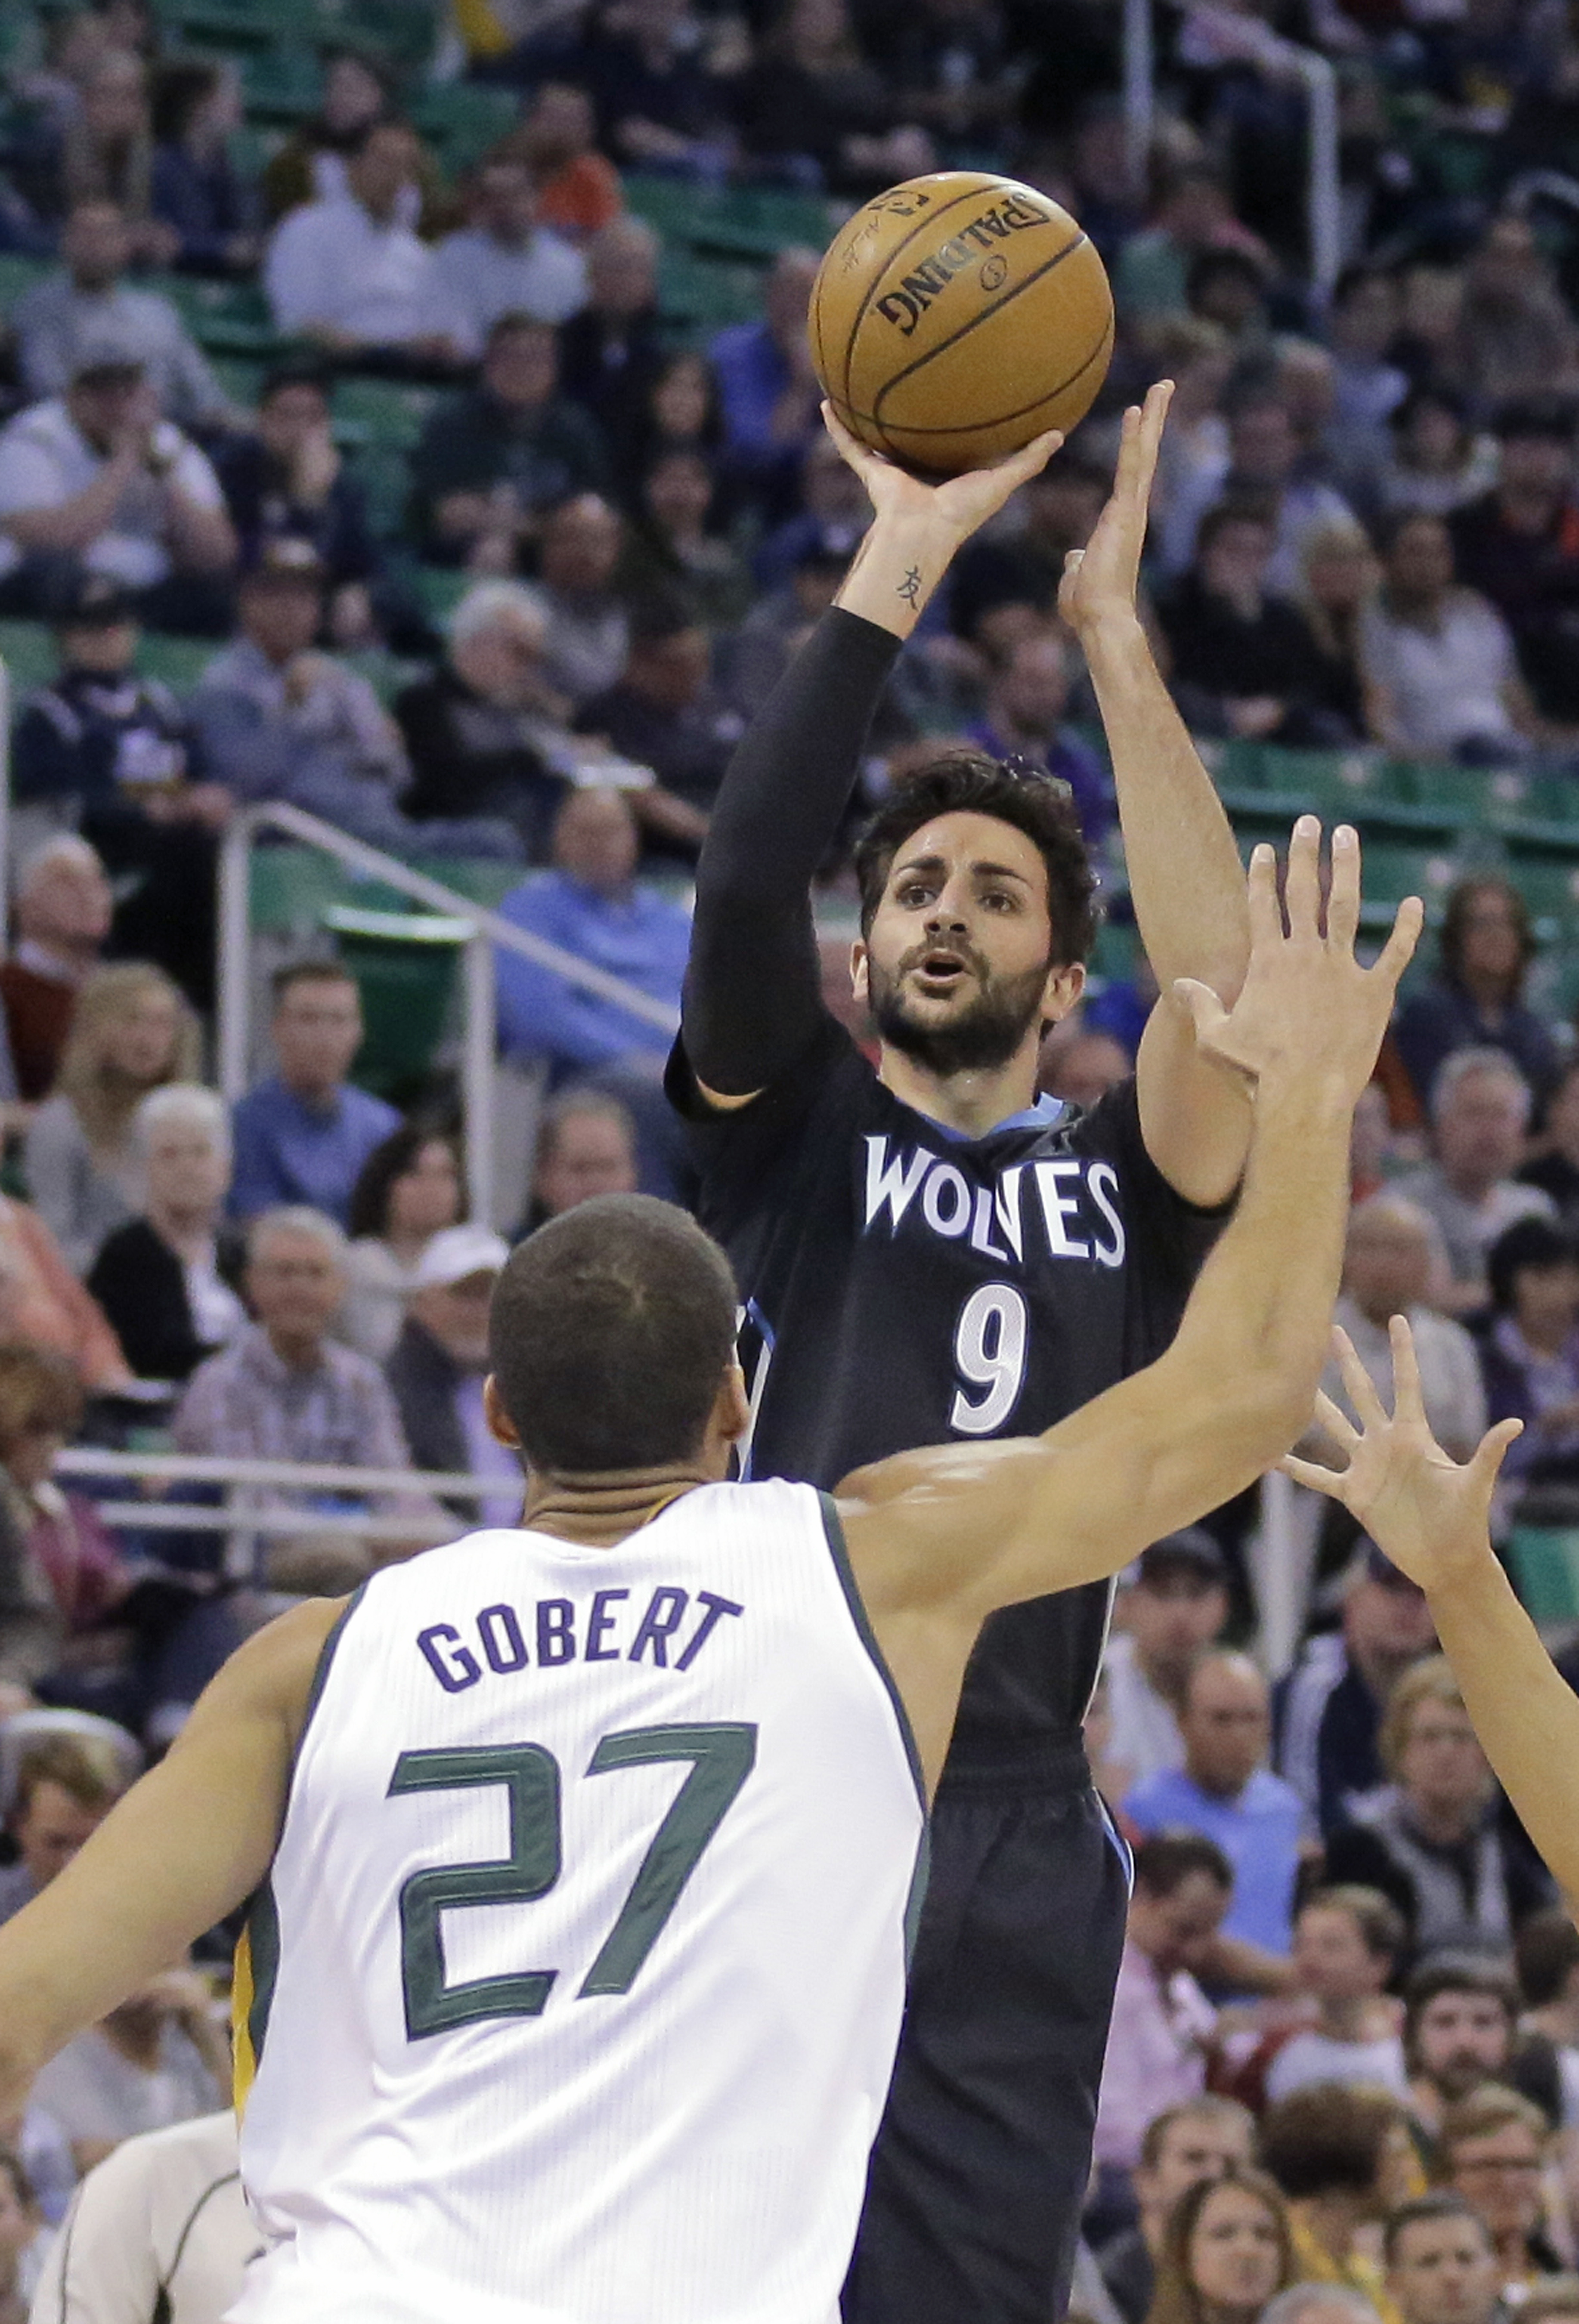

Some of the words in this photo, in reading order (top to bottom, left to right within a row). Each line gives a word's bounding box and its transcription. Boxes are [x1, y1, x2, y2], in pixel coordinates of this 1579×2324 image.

[876, 192, 1050, 337] SPALDING
[864, 1135, 1125, 1268] WOLVES
[950, 1283, 1027, 1434] 9
[416, 1586, 744, 1694] GOBERT
[385, 1721, 759, 2043] 27
